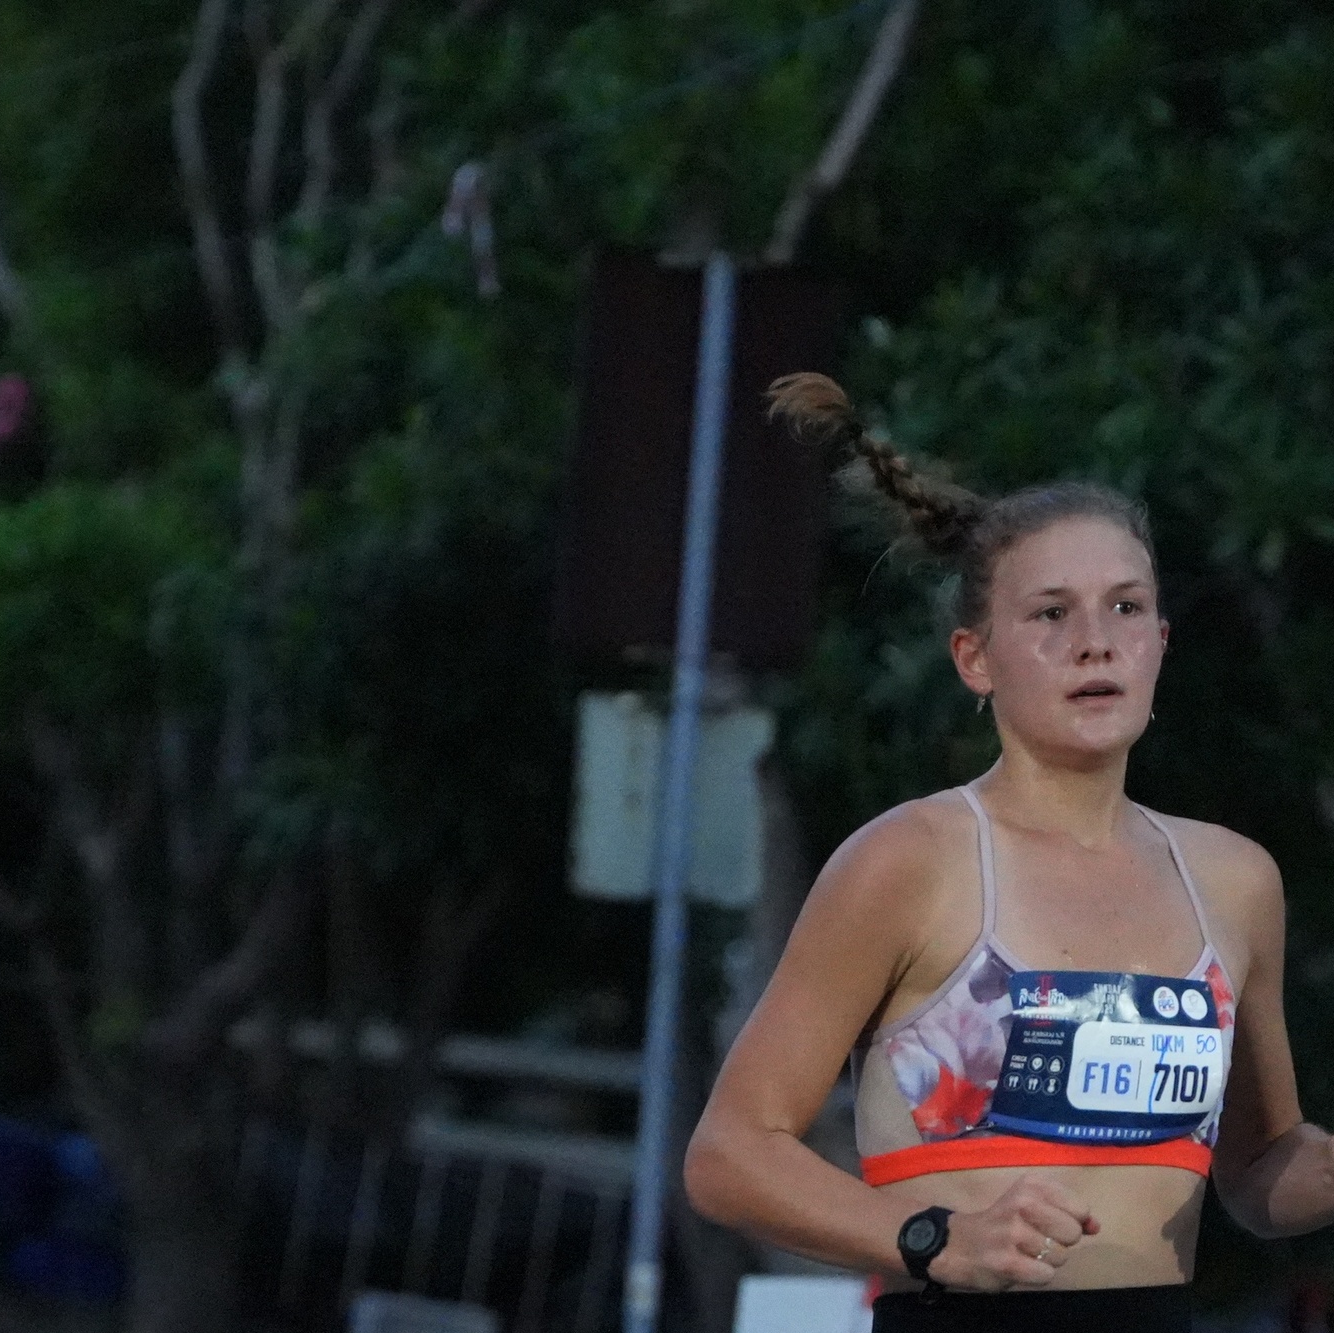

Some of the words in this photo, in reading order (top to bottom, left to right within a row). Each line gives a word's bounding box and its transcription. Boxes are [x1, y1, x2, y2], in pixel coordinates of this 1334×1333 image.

[1110, 1035, 1145, 1047] DISTANCE
[1152, 1033, 1185, 1053] 10KM
[1196, 1034, 1217, 1055] 50
[1082, 1062, 1132, 1095] F16
[1154, 1063, 1209, 1103] 7101
[1058, 1125, 1152, 1139] MINIMARATHON
